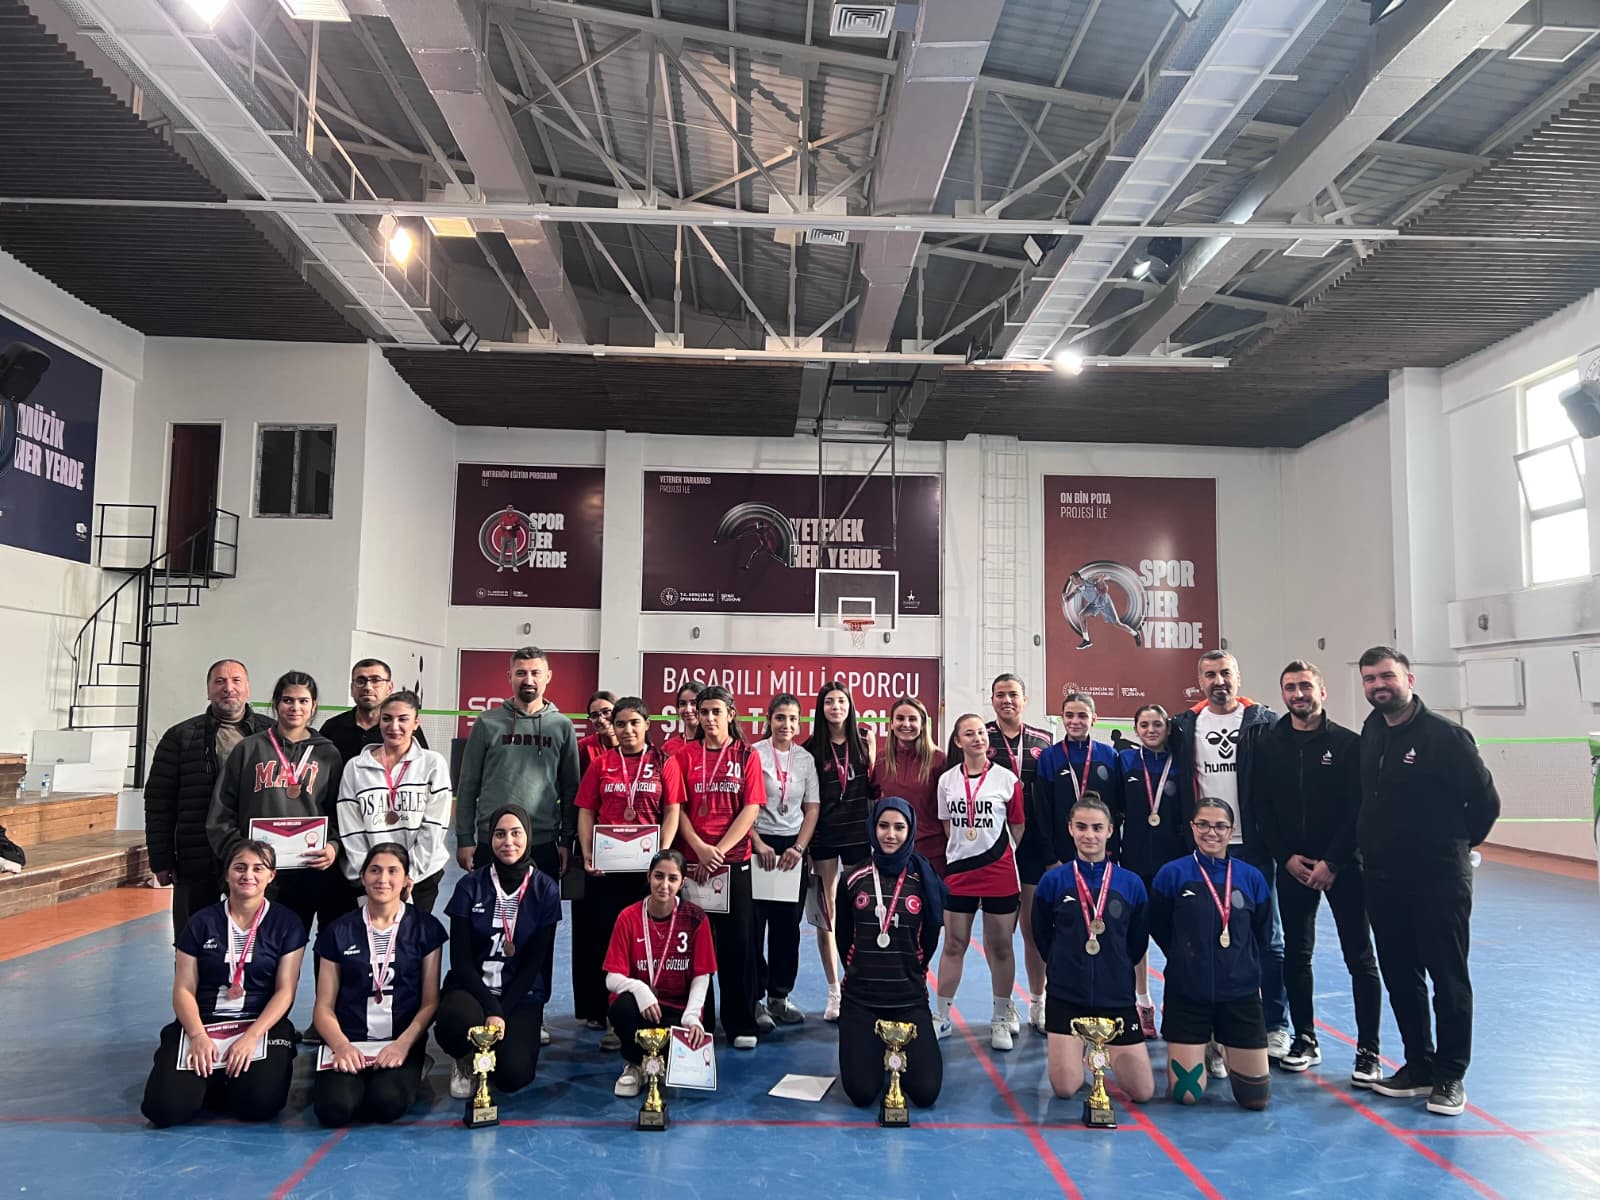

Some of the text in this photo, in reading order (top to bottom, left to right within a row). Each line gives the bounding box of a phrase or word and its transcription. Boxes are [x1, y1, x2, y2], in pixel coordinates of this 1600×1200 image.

[17, 403, 65, 450] MÜZİK
[14, 437, 84, 491] HER YERDE
[1060, 490, 1112, 505] ON BİN POTA
[529, 512, 564, 531] SPOR
[1060, 505, 1108, 519] PROJESİ İLE
[790, 518, 865, 542] YETENEK
[528, 531, 553, 549] HER
[528, 550, 567, 568] YERDE
[827, 548, 882, 569] YERDE
[1139, 559, 1195, 588] SPOR
[1141, 590, 1179, 618] HER
[1140, 620, 1203, 650] YERDE
[770, 666, 826, 697] MİLLİ
[643, 763, 654, 779] 5
[726, 760, 741, 778] 20
[1204, 761, 1237, 774] humm
[946, 798, 993, 815] AĞUR
[951, 817, 993, 829] URZM
[676, 931, 689, 953] 3
